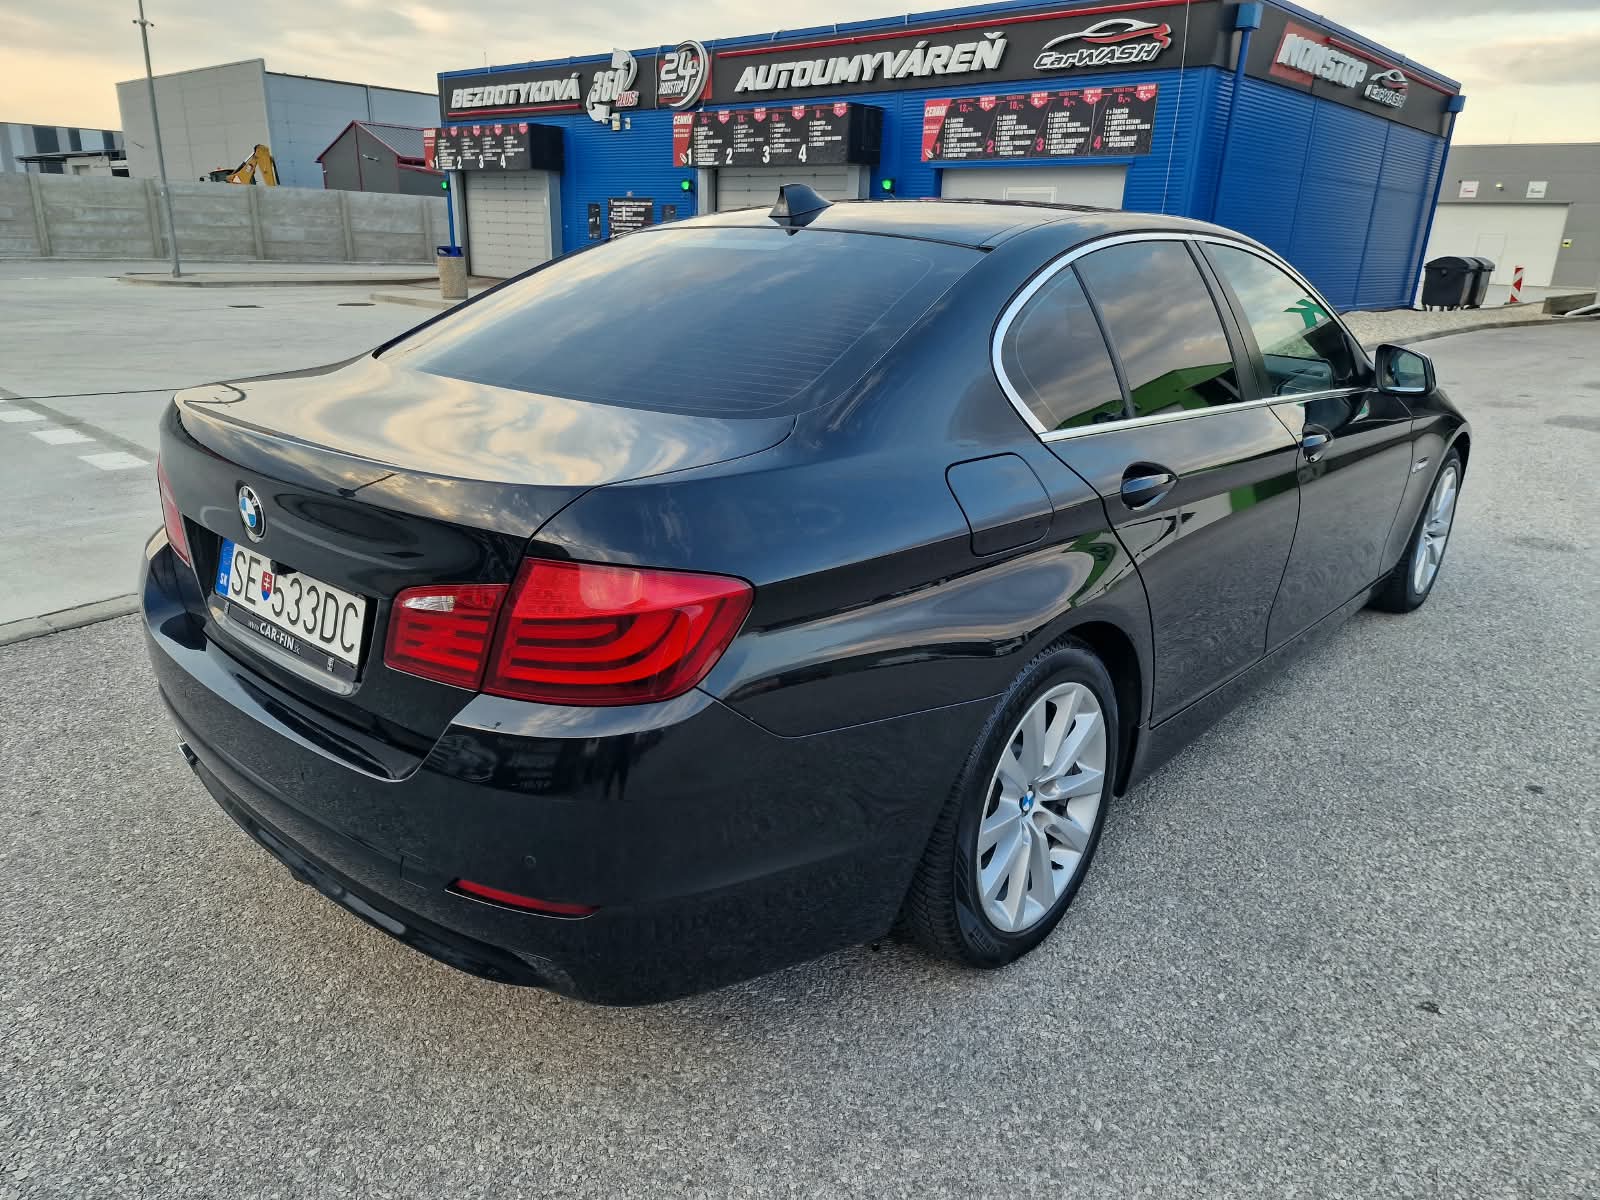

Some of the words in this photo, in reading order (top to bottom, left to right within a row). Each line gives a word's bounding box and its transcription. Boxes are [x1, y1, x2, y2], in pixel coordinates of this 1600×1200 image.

[734, 32, 1007, 92] AUTOUMYVÁREŇ
[1033, 43, 1160, 70] CarWASH
[1276, 33, 1368, 88] NONSTOP
[660, 51, 697, 92] 24
[451, 73, 581, 109] BEZDOTYKOVÁ
[591, 70, 628, 102] 360
[935, 143, 940, 154] 1
[986, 140, 994, 153] 2
[1035, 137, 1044, 151] 3
[1093, 135, 1102, 149] 4
[479, 155, 484, 168] 3
[500, 154, 506, 168] 4
[686, 148, 692, 165] 1
[725, 148, 733, 165] 2
[762, 145, 770, 163] 3
[798, 144, 807, 162] 4
[435, 155, 439, 169] 1
[457, 156, 462, 169] 2
[231, 550, 261, 606] SE
[271, 573, 358, 653] 533DC
